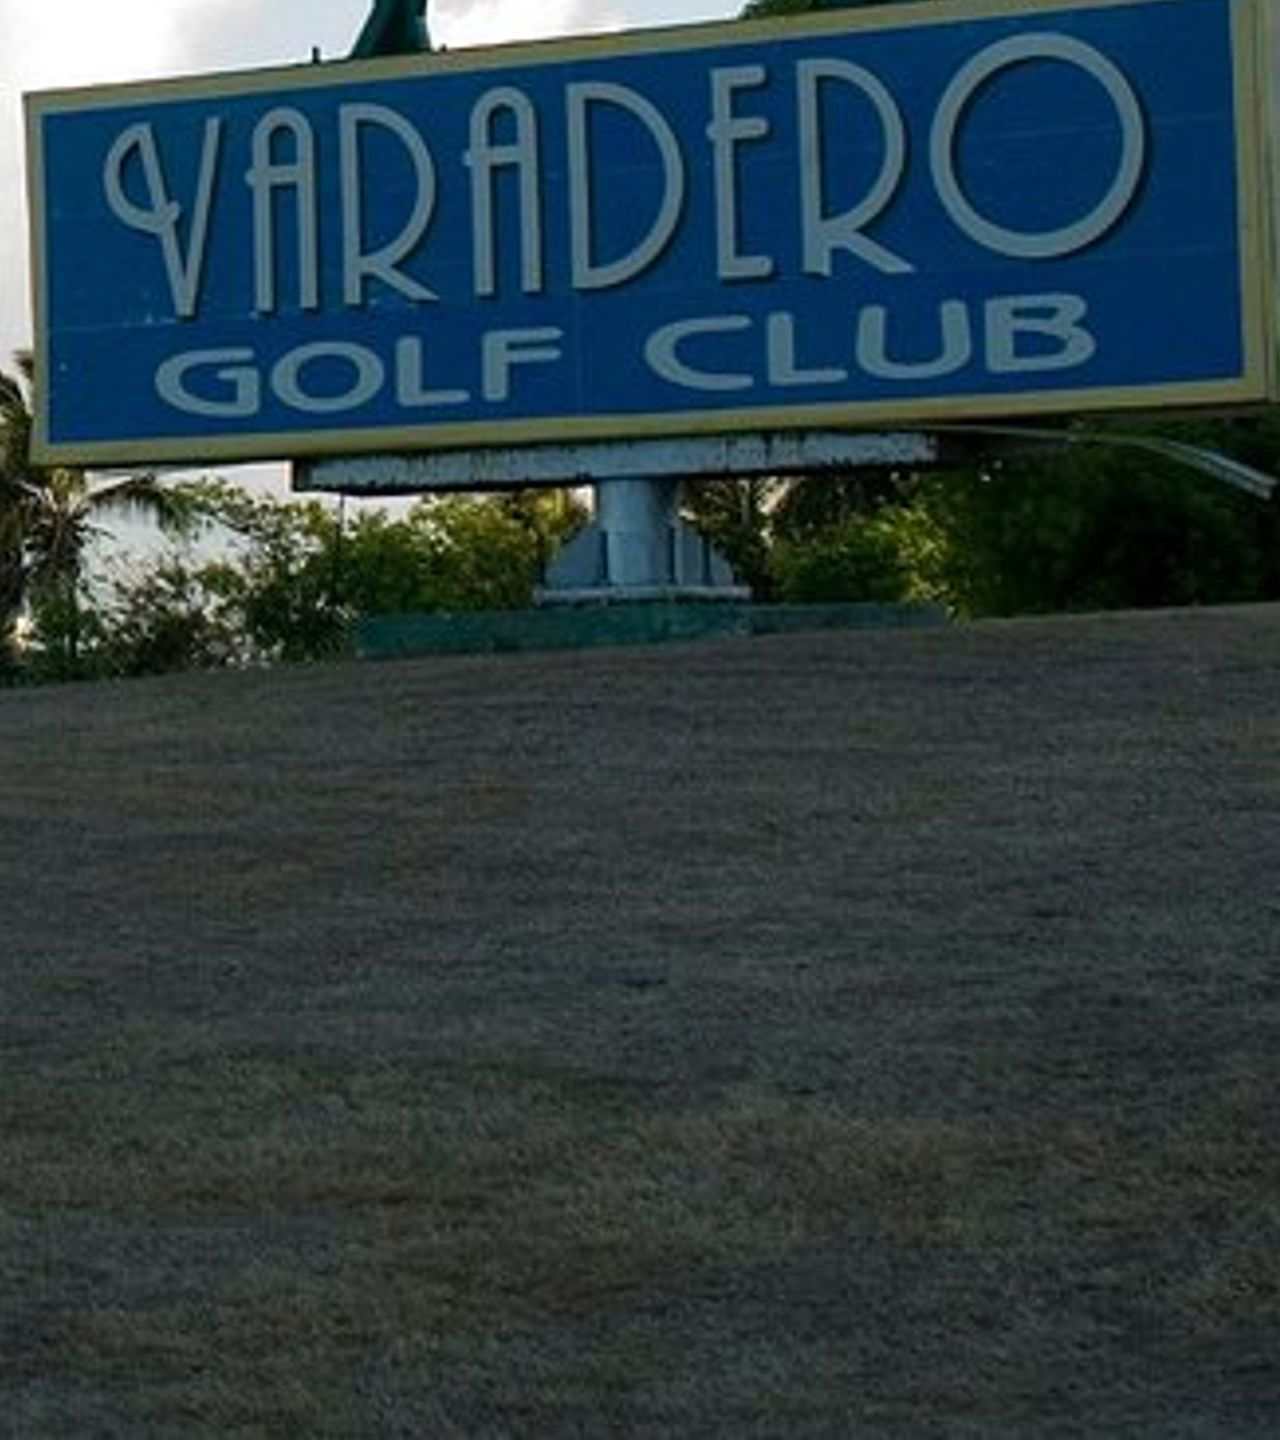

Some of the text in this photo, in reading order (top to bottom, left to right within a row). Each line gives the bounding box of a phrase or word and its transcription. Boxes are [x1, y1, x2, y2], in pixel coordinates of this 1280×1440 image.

[103, 32, 1145, 318] VARADERO
[153, 293, 1098, 418] GOLF CLUB
